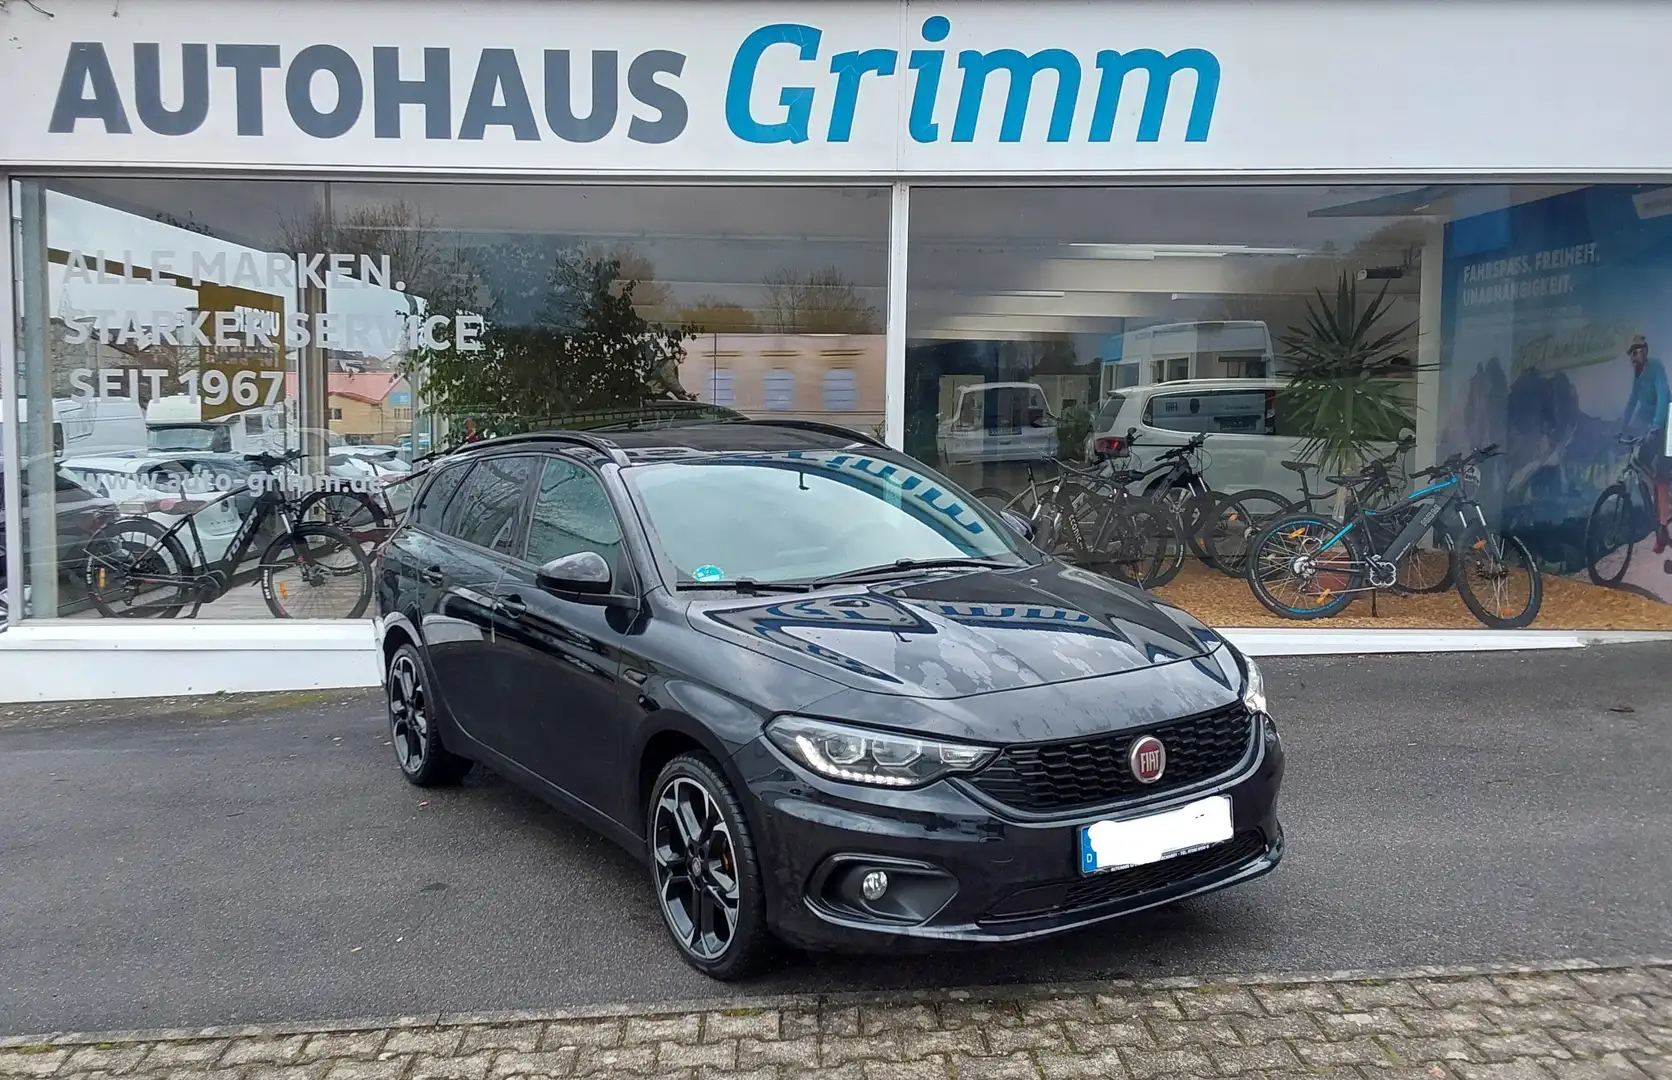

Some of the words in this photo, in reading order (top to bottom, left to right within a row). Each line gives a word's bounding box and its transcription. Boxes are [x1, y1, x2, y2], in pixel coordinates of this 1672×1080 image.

[48, 41, 688, 145] AUTOHAUS
[725, 15, 1221, 145] Grimm
[63, 249, 177, 285] ALLE
[192, 251, 406, 291] MARKEN.
[64, 308, 274, 347] STARKER
[286, 312, 485, 351] SERVICE
[69, 368, 169, 404] SEIT
[1140, 749, 1160, 773] FIAT
[1086, 853, 1093, 864] D
